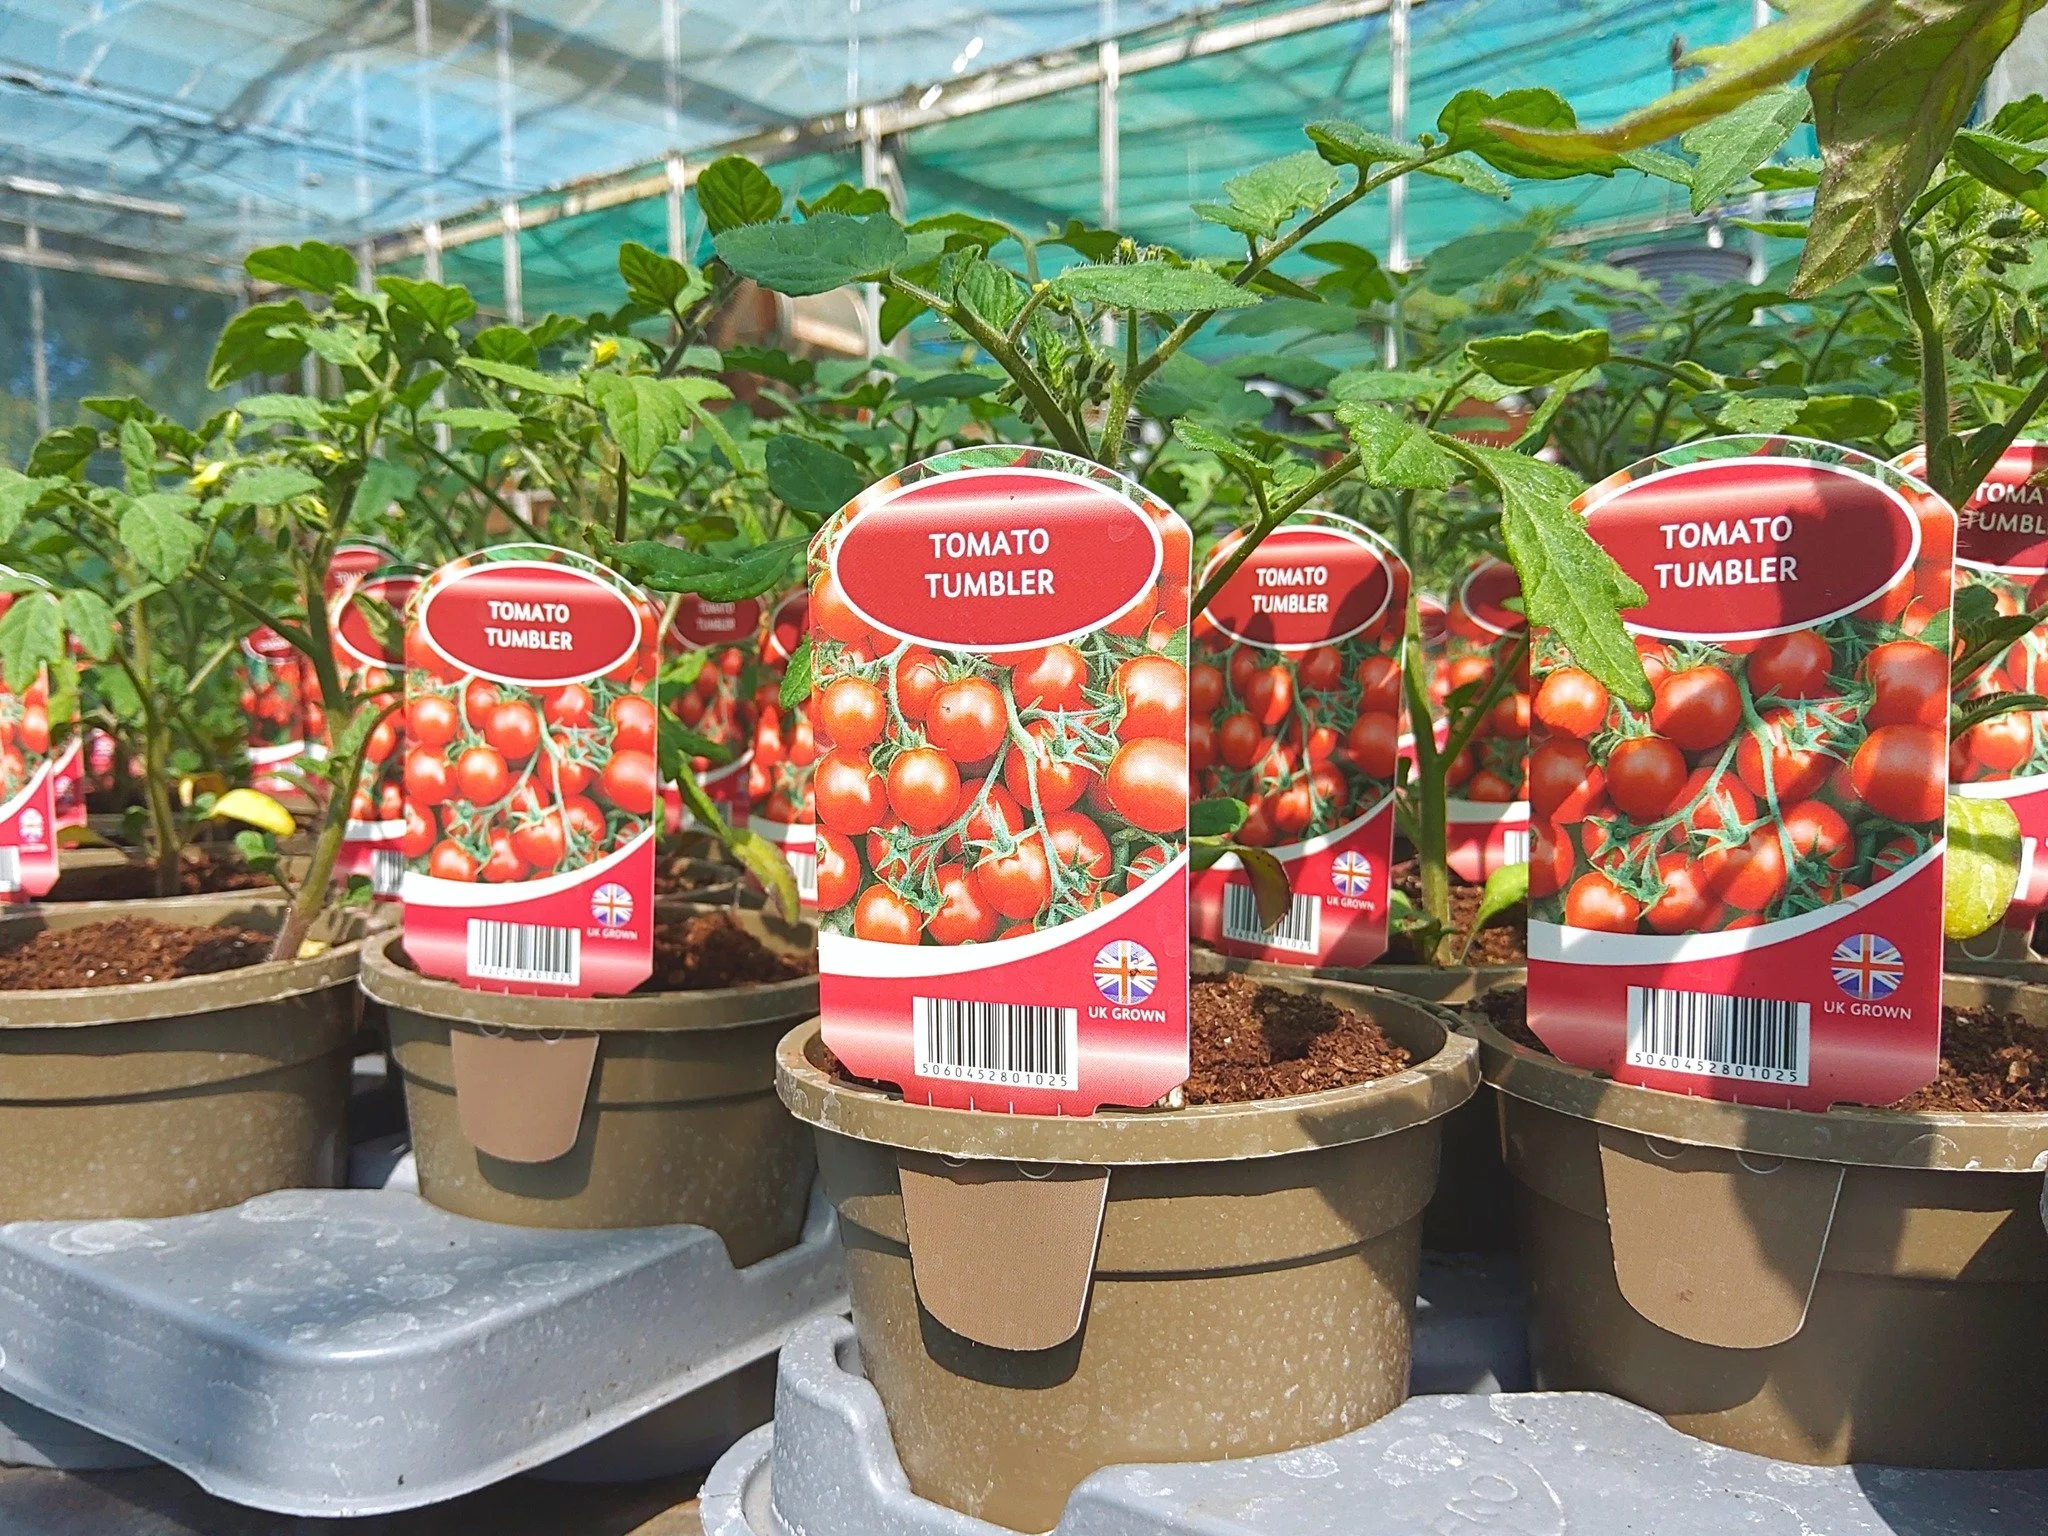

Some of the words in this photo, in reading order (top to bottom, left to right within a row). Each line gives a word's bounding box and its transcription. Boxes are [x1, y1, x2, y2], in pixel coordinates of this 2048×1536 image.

[1975, 482, 2048, 505] TOMA
[1660, 515, 1793, 549] TOMATO
[1963, 509, 2048, 534] TUMBL
[928, 528, 1050, 558] TOMATO
[924, 569, 1055, 598] TUMBLER
[1256, 565, 1328, 587] TOMATO
[1654, 556, 1798, 588] TUMBLER
[487, 600, 570, 623] TOMATO
[1251, 593, 1329, 613] TUMBLER
[484, 627, 573, 650] TUMBLER
[1326, 895, 1339, 906] UK
[1341, 898, 1375, 911] GROWN
[1088, 1005, 1108, 1019] UK
[1112, 1009, 1166, 1023] GROWN
[1824, 1000, 1845, 1015] UK
[1850, 1003, 1912, 1020] GROWN
[922, 1063, 1068, 1087] 5060452801025
[1635, 1052, 1798, 1083] 5060452801025
